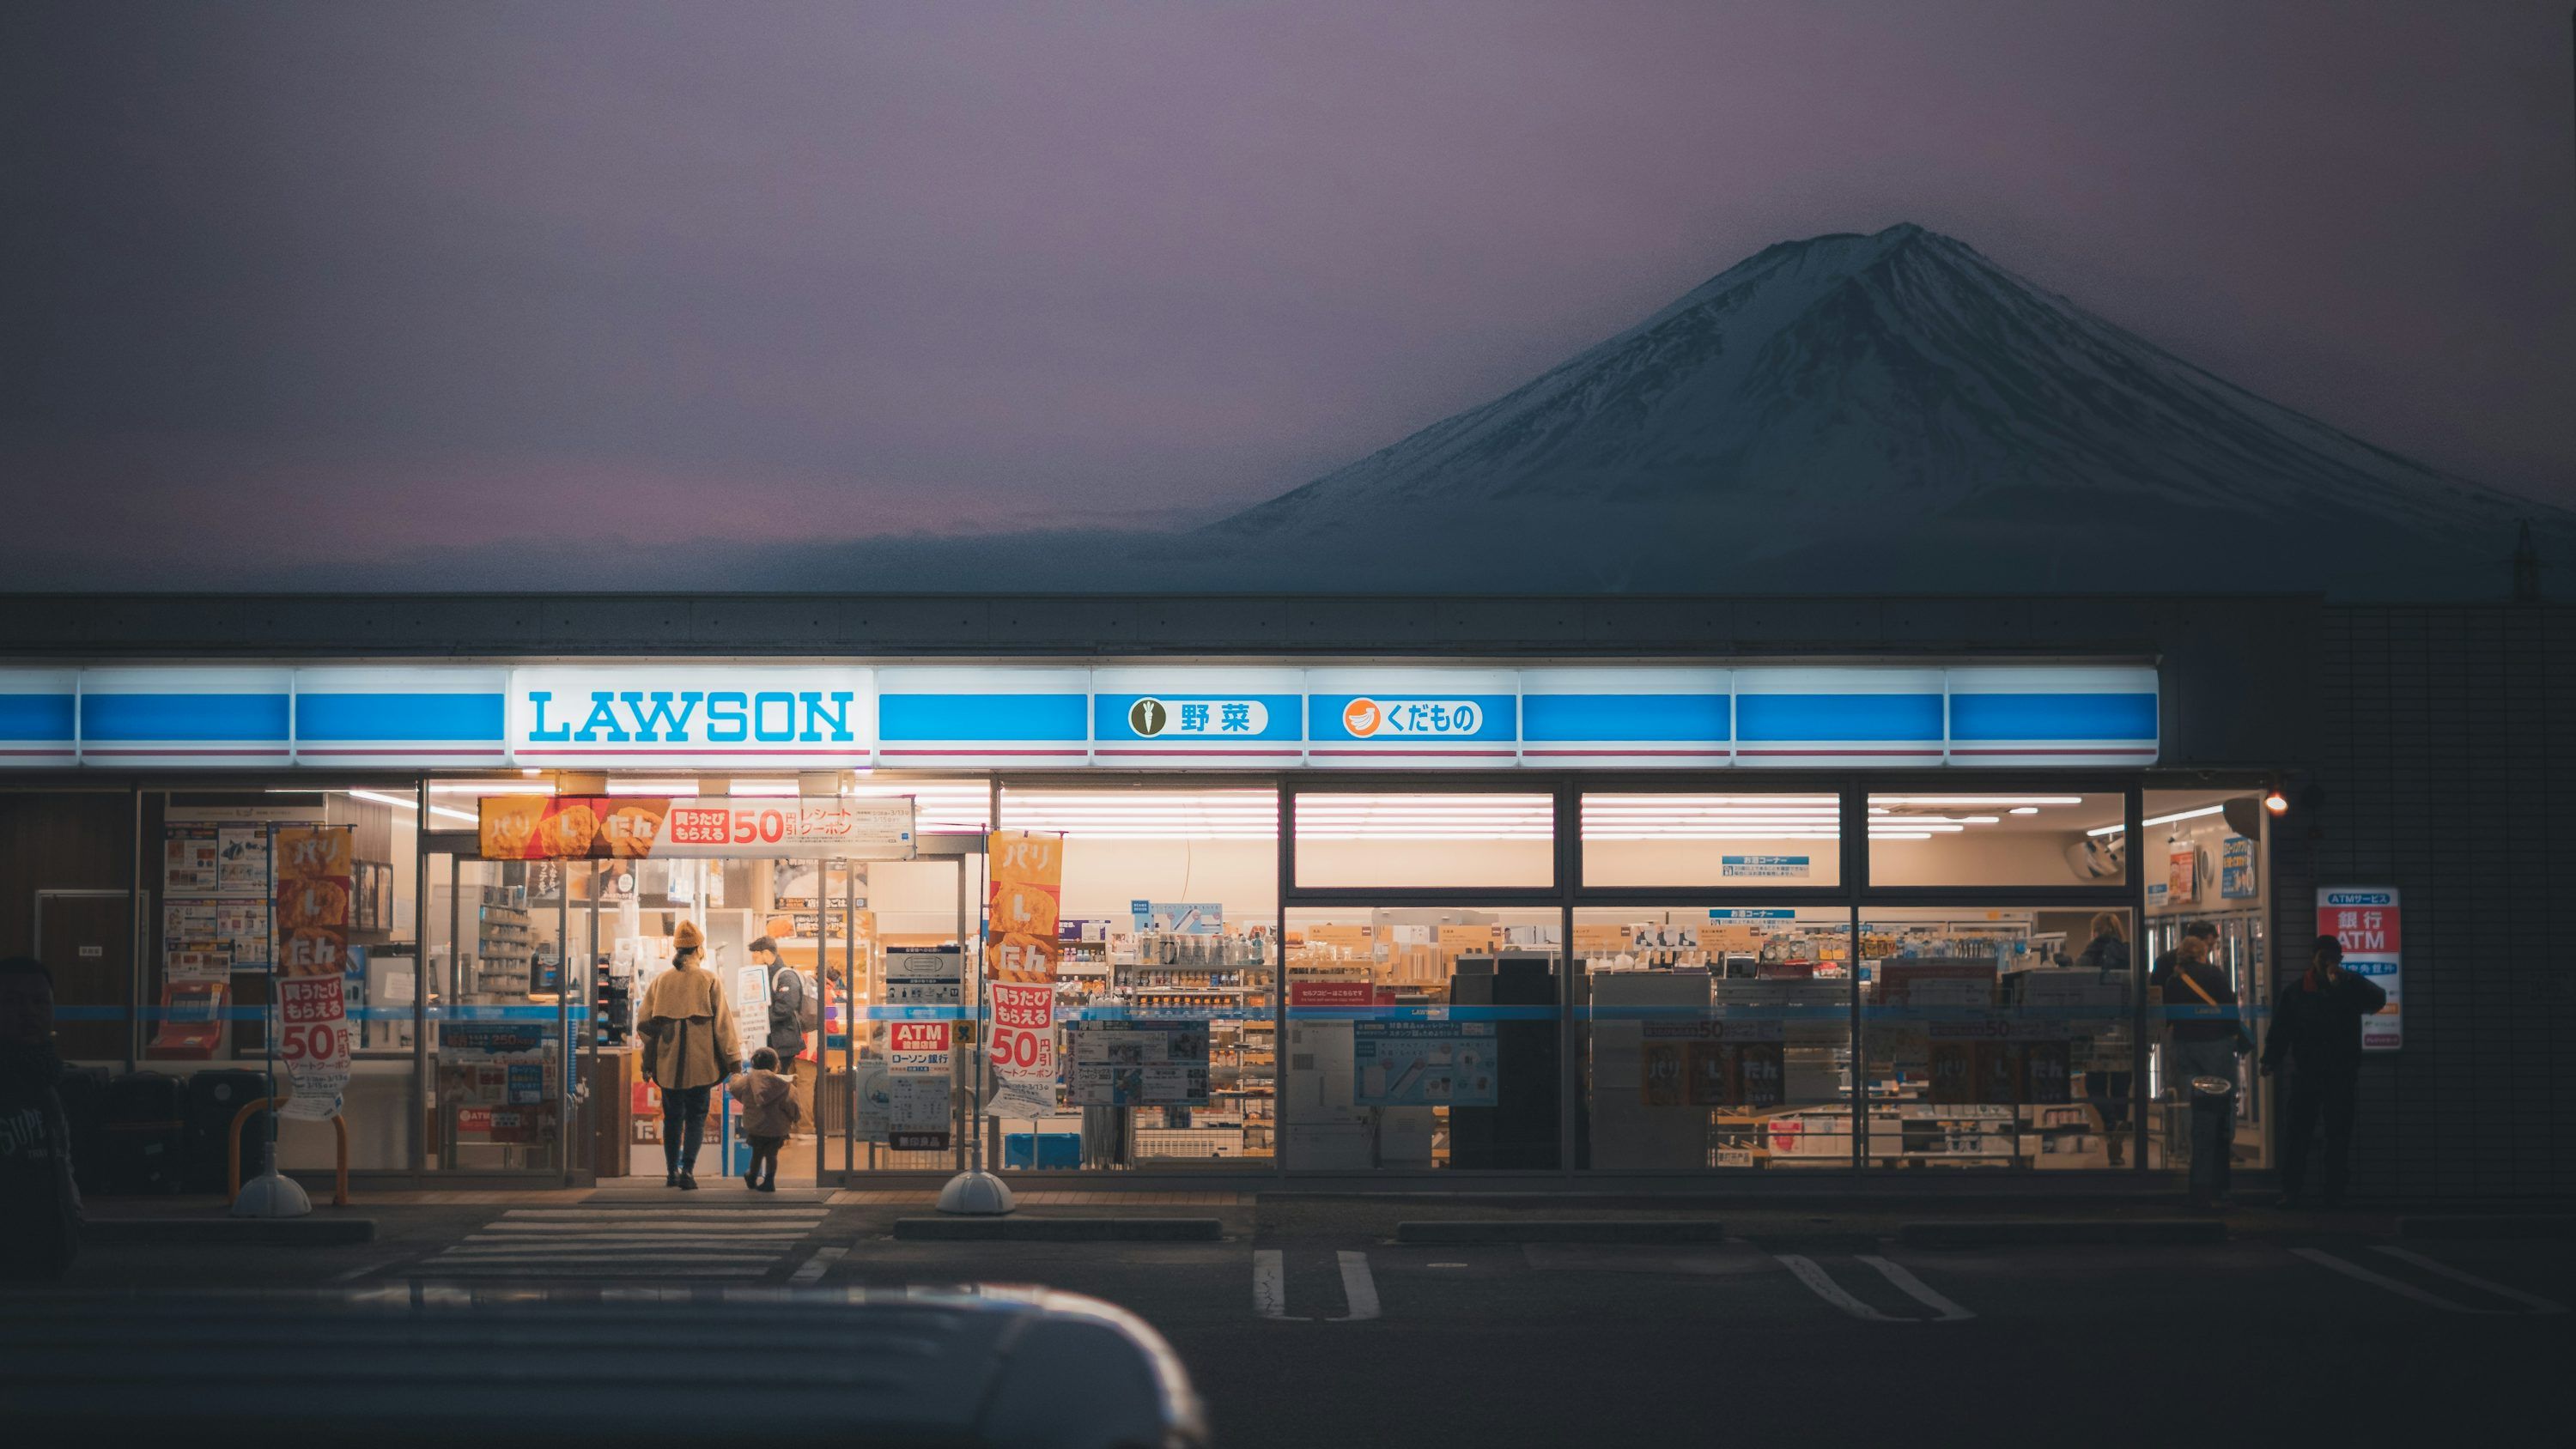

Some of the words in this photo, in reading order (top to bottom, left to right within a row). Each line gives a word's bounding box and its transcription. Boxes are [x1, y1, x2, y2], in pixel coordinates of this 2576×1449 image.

[529, 691, 854, 743] LAWSON
[1181, 704, 1250, 732] 野菜
[1387, 704, 1474, 732] くだもの
[675, 811, 726, 826] 買うたび
[800, 808, 852, 822] レシート
[676, 827, 725, 841] もらえる
[733, 809, 784, 844] 50
[801, 822, 852, 835] クーポン
[2331, 894, 2387, 903] ATMサービス
[2338, 911, 2382, 929] 銀行
[2337, 931, 2385, 949] ATM
[284, 979, 340, 1001] 買うたび
[995, 986, 1051, 1007] 買うたび
[287, 1000, 342, 1020] もらえる
[998, 1005, 1048, 1026] もらえる
[897, 1024, 942, 1041] ATM
[1698, 1021, 1723, 1038] 50
[1986, 1020, 2010, 1037] 50
[282, 1023, 334, 1060] 50
[990, 1028, 1038, 1068] 50
[892, 1054, 949, 1064] ローソン銀行
